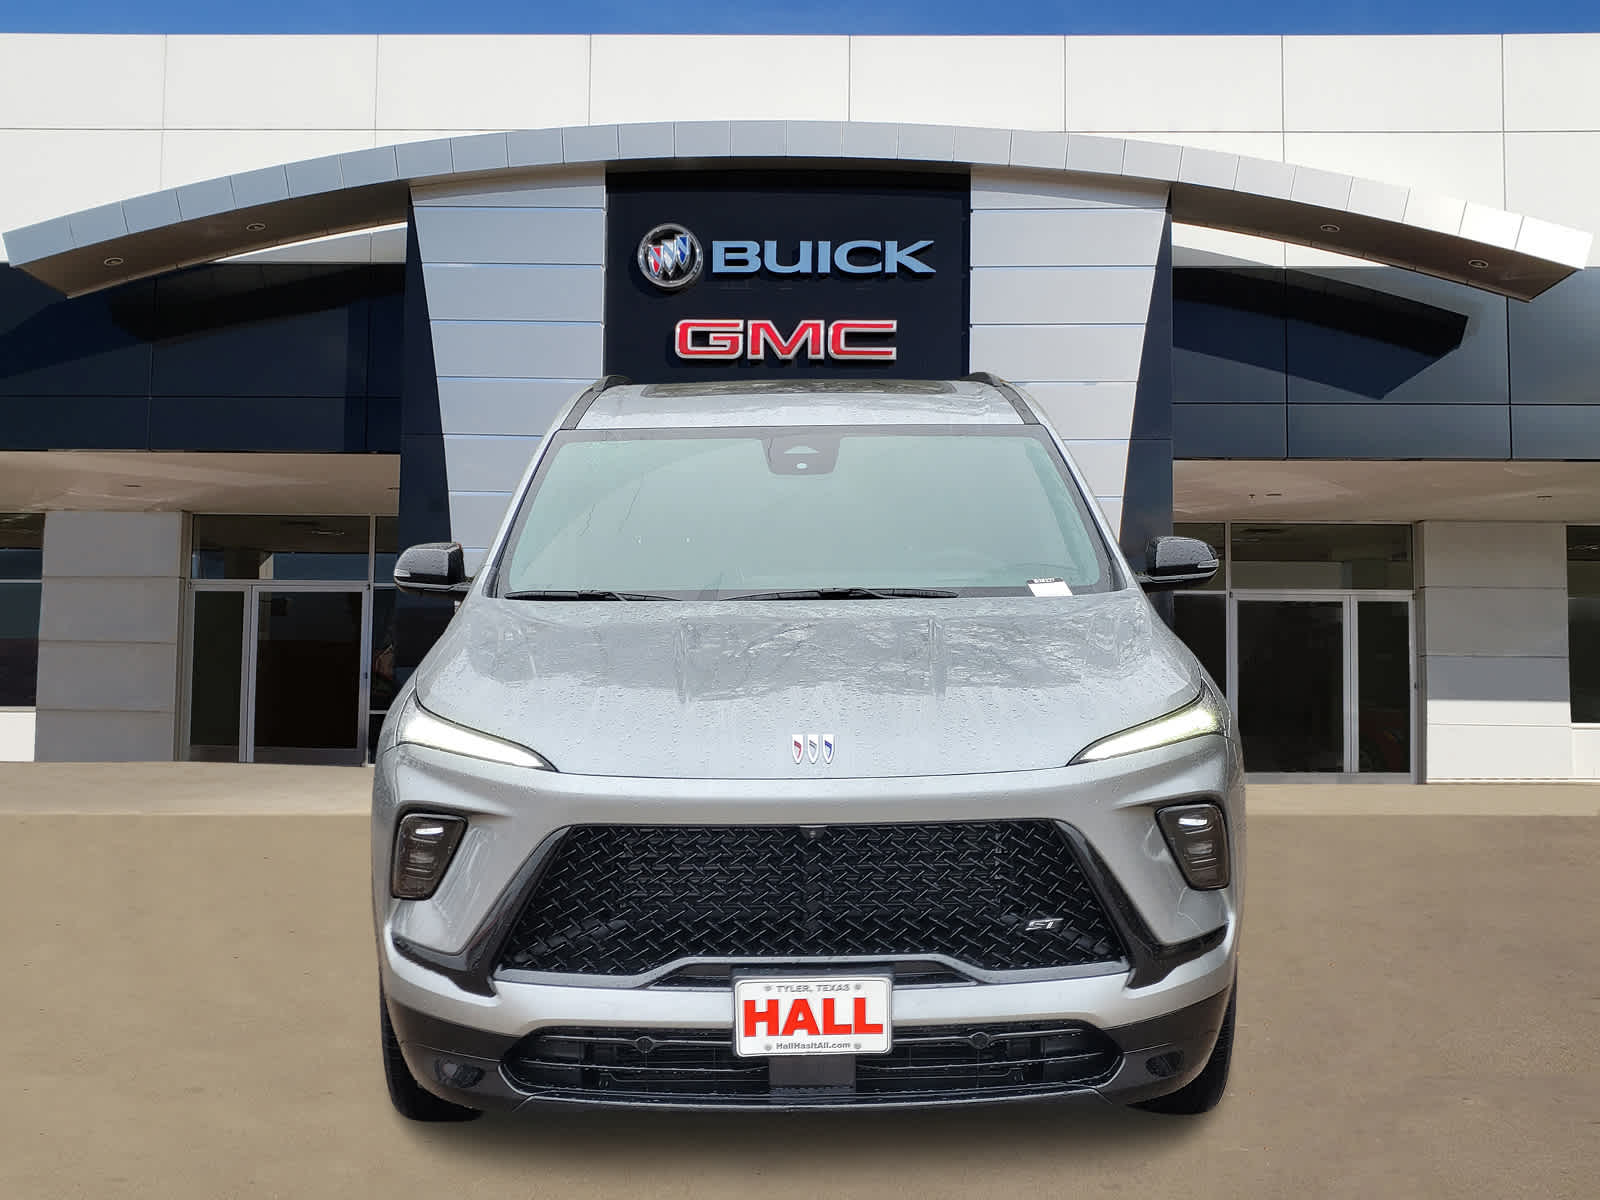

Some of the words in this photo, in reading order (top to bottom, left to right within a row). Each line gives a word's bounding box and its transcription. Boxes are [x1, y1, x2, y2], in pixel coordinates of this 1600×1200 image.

[712, 240, 937, 274] BUICK
[675, 319, 898, 361] GMC
[776, 985, 813, 993] TYLER,
[816, 984, 850, 992] TEXAS
[743, 997, 884, 1038] HALL
